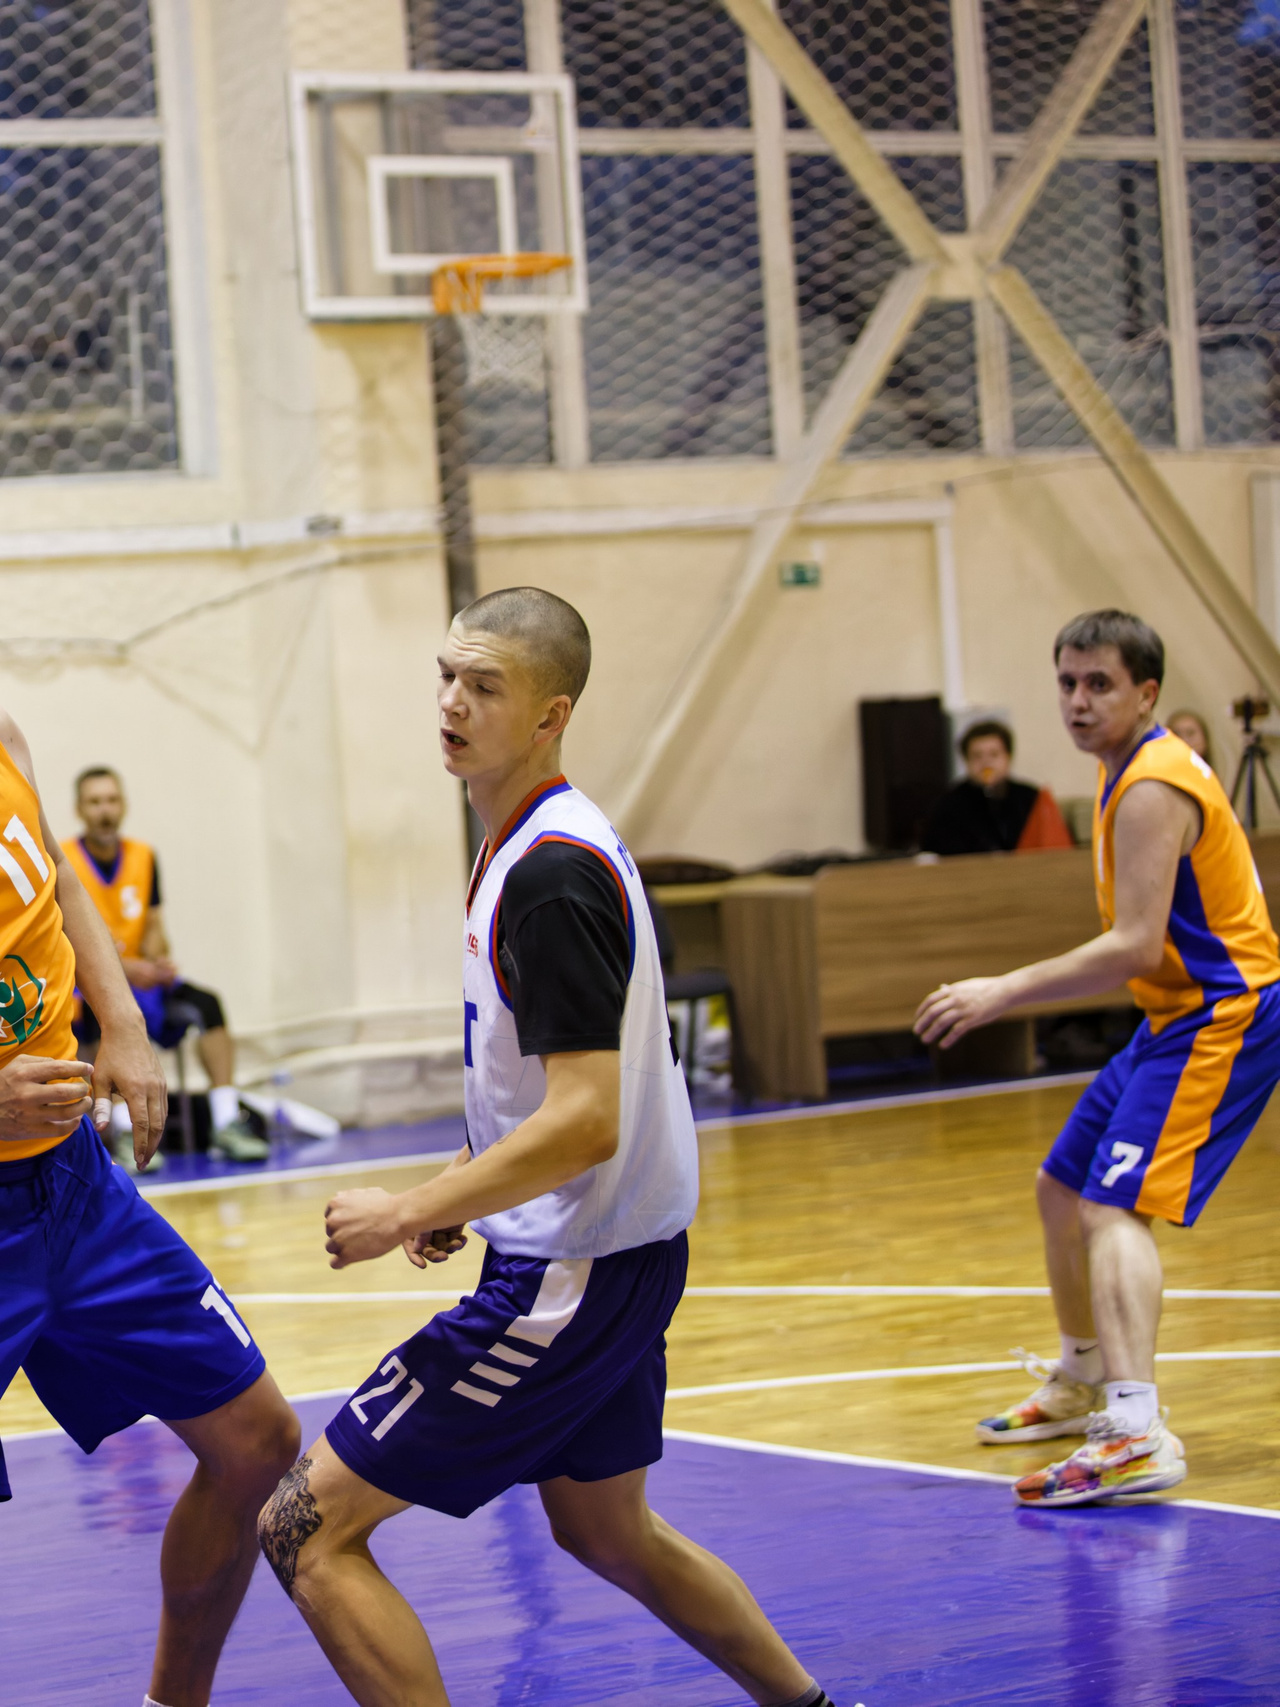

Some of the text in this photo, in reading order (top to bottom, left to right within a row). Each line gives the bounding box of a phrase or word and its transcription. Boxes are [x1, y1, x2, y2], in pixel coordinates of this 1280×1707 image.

[1100, 1140, 1144, 1189] 7
[200, 1275, 251, 1348] 1
[349, 1355, 424, 1441] 21
